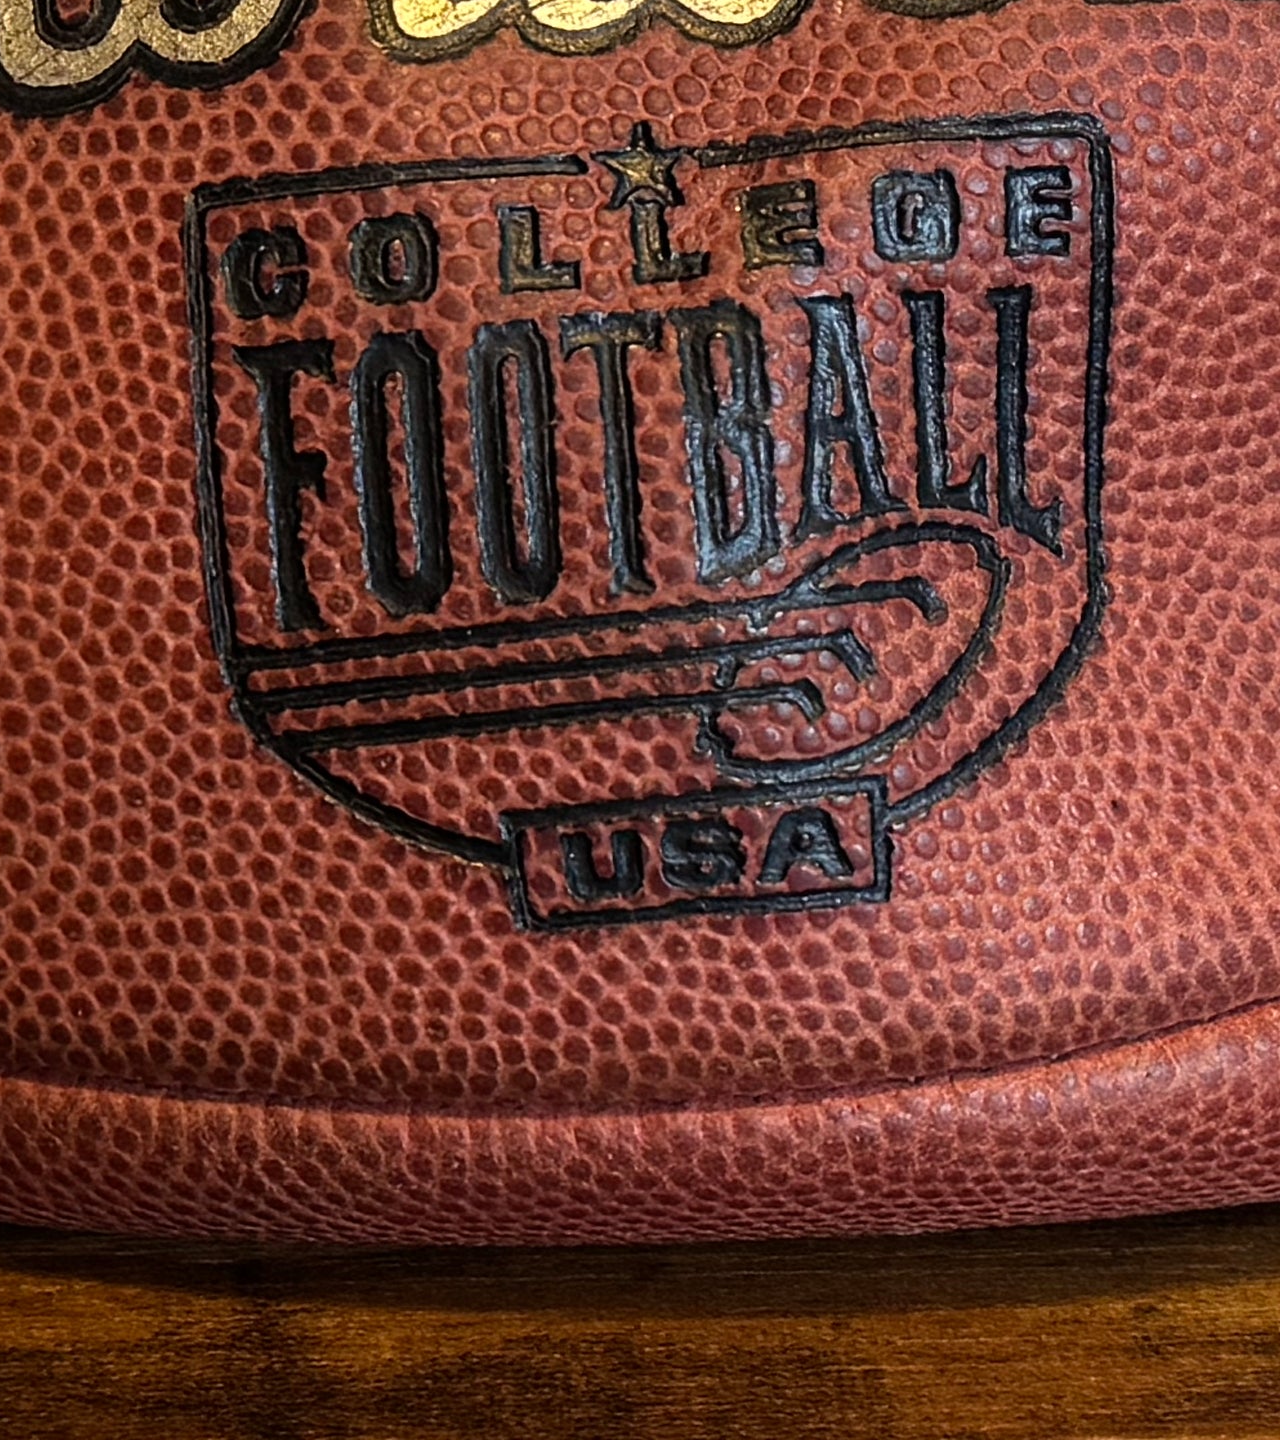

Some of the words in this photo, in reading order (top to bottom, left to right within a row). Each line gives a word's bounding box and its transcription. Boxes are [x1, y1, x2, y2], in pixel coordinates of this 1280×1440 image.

[219, 164, 1074, 320] COLLEGE
[231, 283, 1067, 632] FOOTBALL
[560, 807, 854, 901] USA
